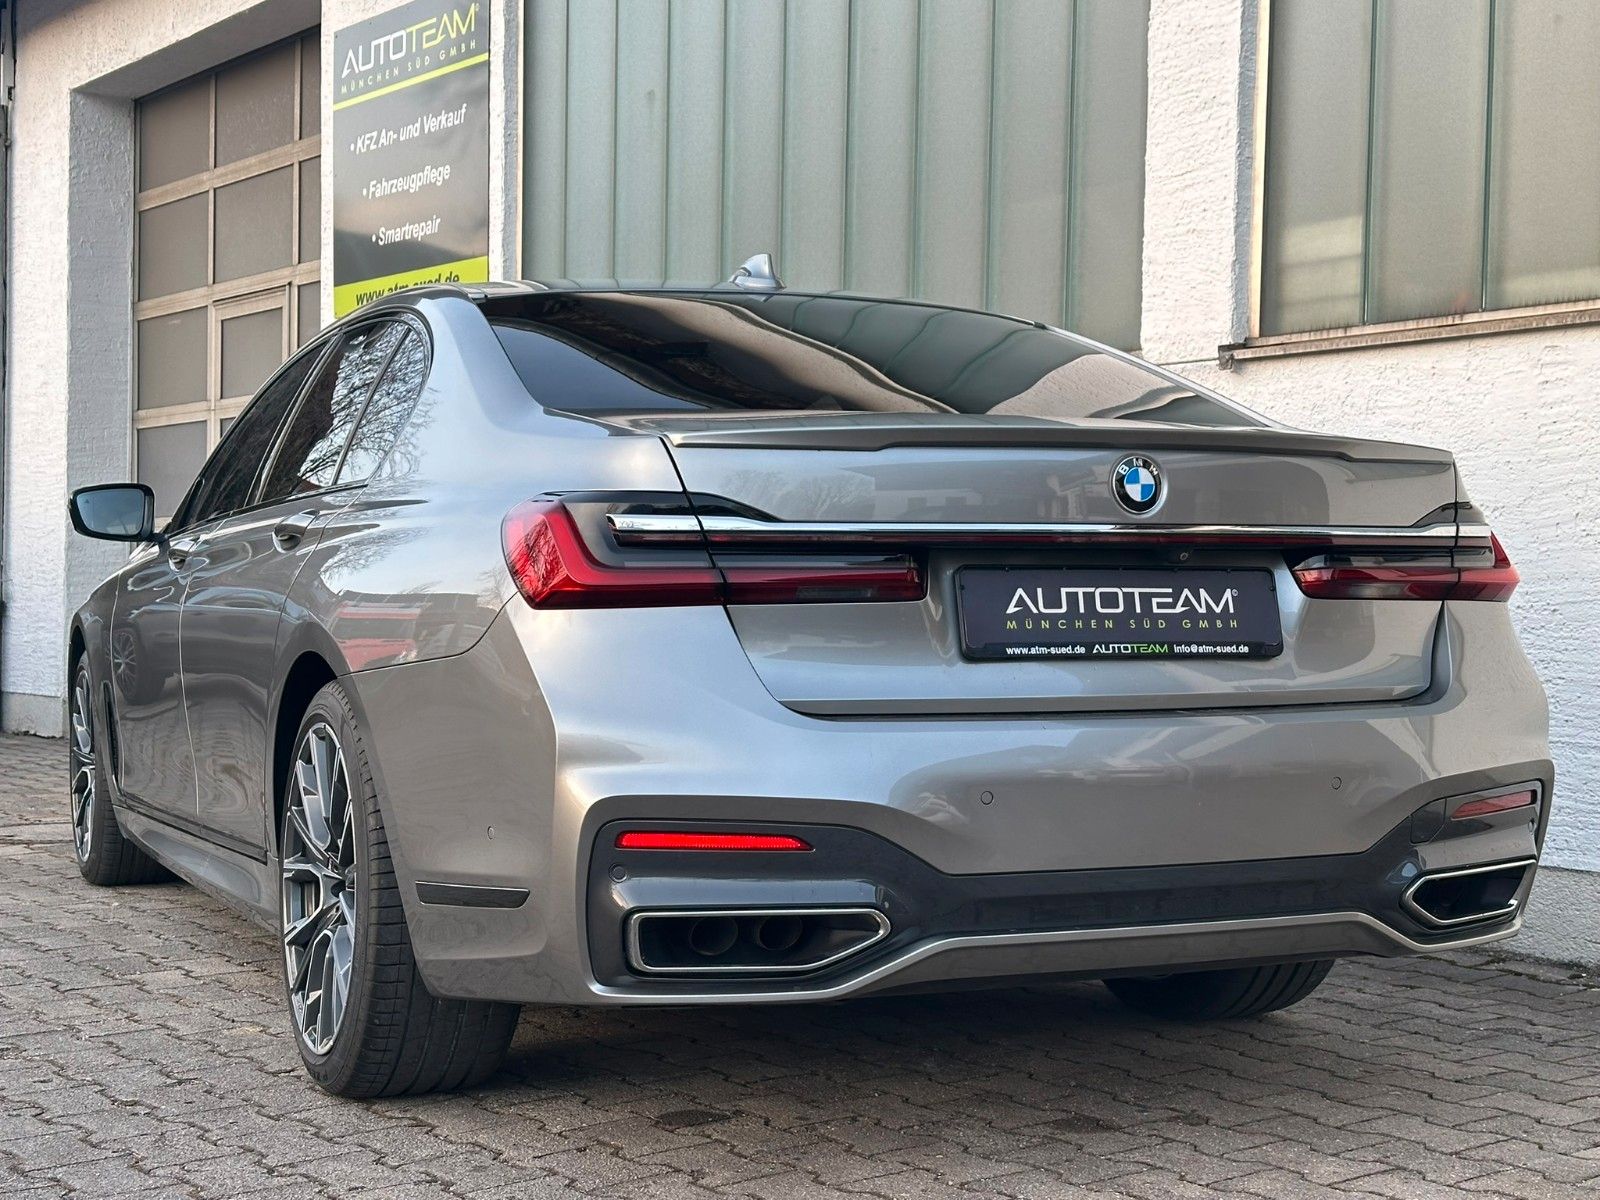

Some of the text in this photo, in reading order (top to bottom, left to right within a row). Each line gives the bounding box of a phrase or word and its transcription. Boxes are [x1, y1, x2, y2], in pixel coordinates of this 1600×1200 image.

[341, 39, 476, 95] MÜNCHEN SÜD GMBH
[356, 103, 467, 155] KFZ An- und Verkauf
[369, 164, 451, 199] Fahrzeugpflege
[378, 215, 441, 246] Smartrepair
[1118, 457, 1159, 476] BMW
[1006, 618, 1239, 630] MÜNCHEN SÜD GMBH
[1005, 643, 1249, 655] www.atm-sued.de AUTOTEAM info@atm-sued.de
